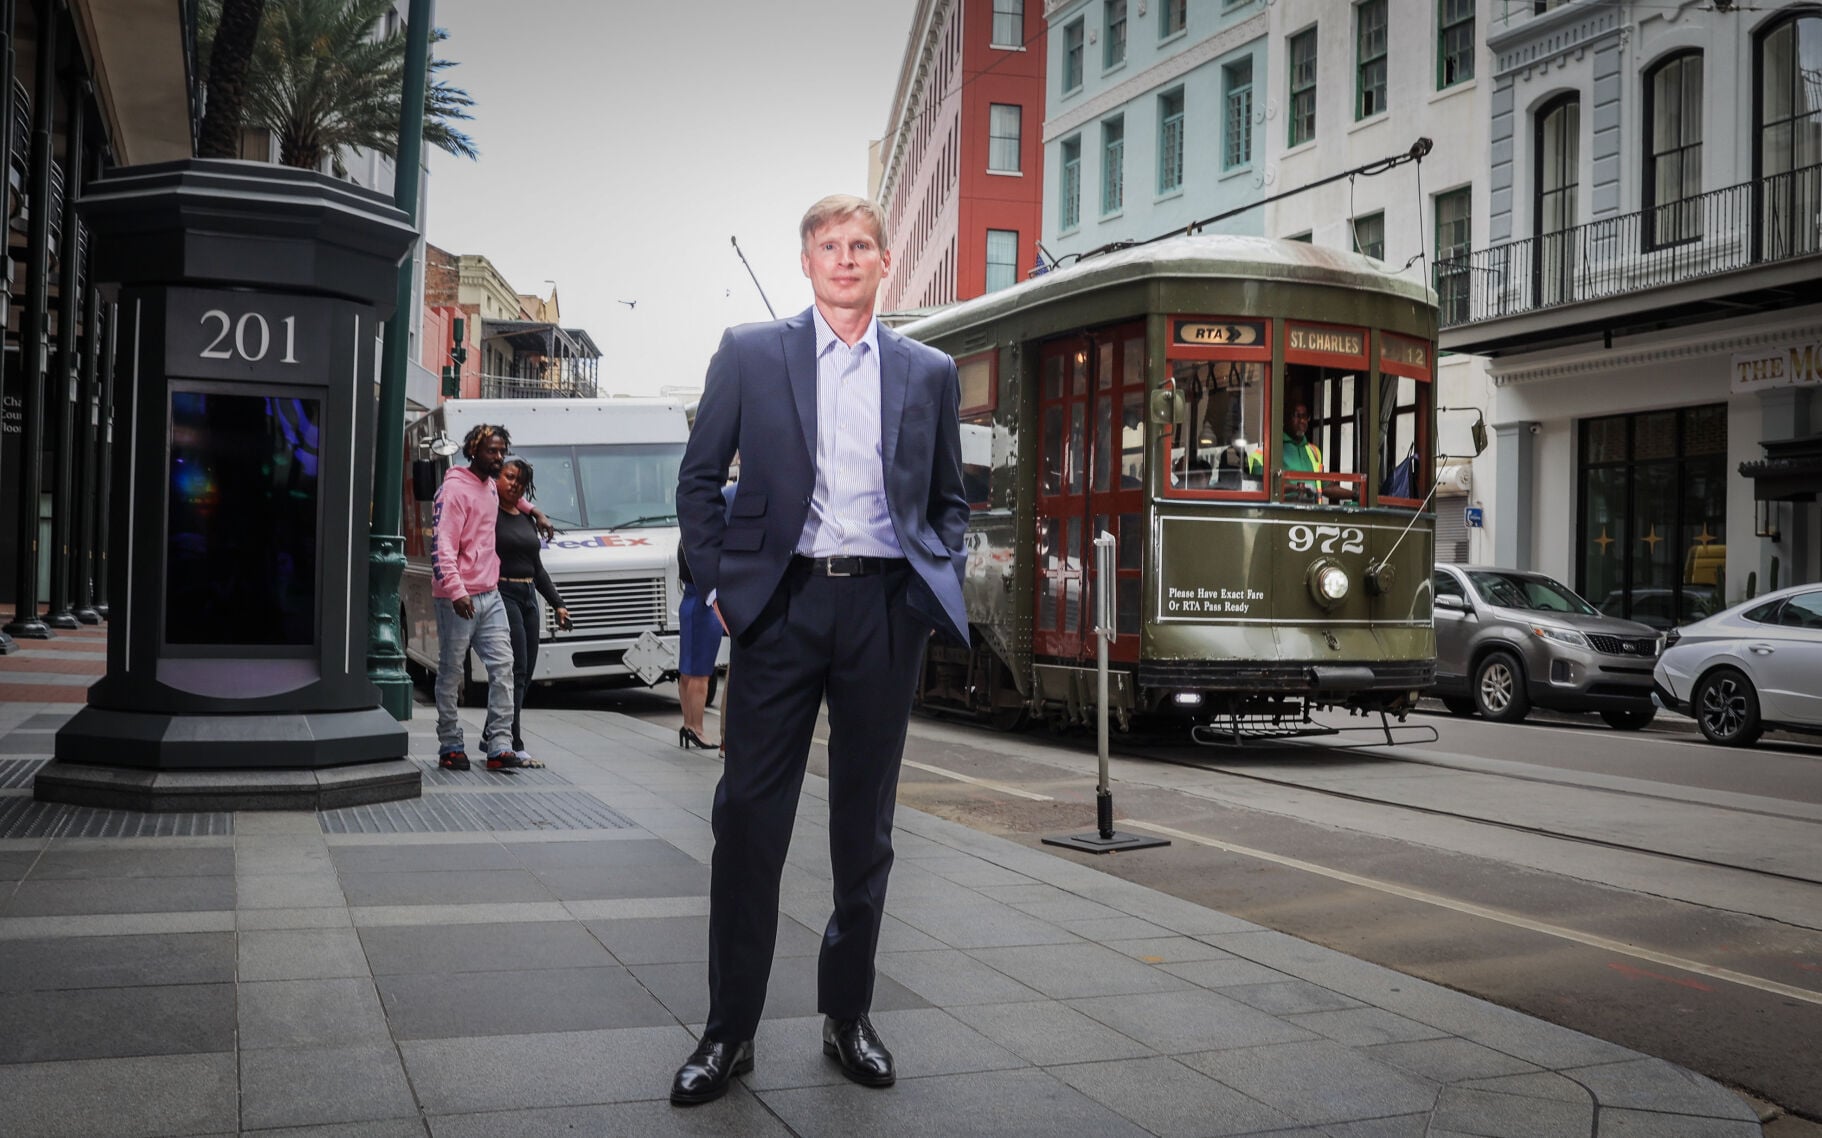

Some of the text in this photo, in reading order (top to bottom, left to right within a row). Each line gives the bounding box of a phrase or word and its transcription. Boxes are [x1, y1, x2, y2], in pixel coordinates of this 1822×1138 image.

[199, 309, 300, 363] 201
[1195, 327, 1223, 339] RTA
[1290, 330, 1359, 354] ST. CHARLES
[1406, 346, 1425, 364] 12
[1737, 357, 1784, 383] THE
[1288, 525, 1364, 554] 972
[1168, 587, 1264, 600] Please Have Exact Fare
[1168, 600, 1249, 613] Or RTA Pass Ready
